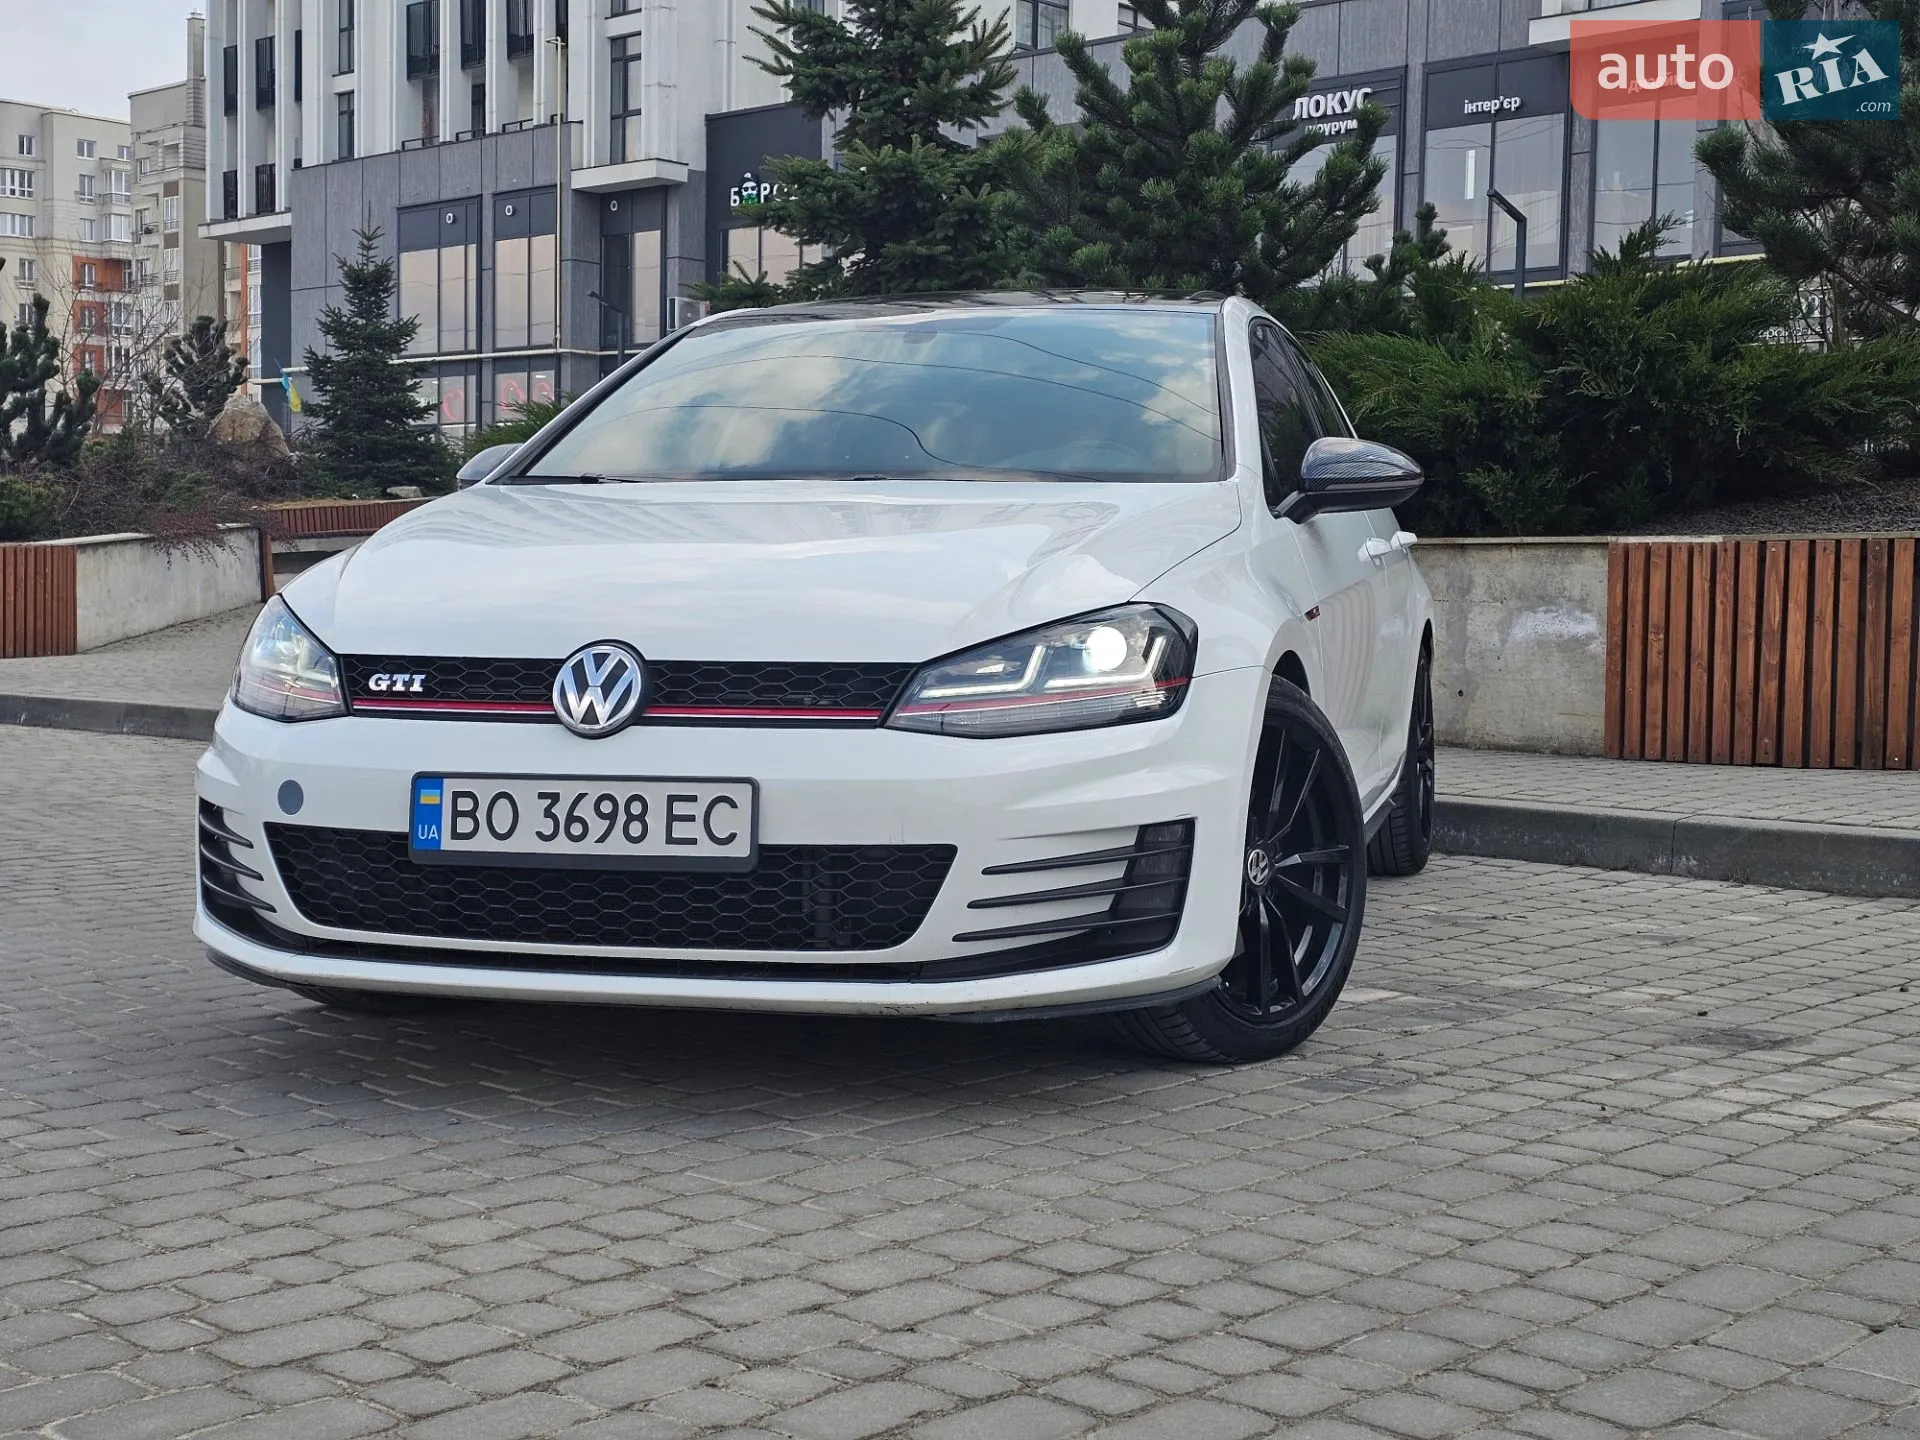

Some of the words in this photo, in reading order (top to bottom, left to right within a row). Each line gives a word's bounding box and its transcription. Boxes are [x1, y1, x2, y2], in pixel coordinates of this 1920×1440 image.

[1292, 87, 1374, 120] ЛОКУС
[368, 673, 426, 692] GTI
[450, 790, 520, 841] BO
[535, 791, 649, 845] 3698
[665, 793, 738, 846] EC
[418, 824, 439, 840] UA
